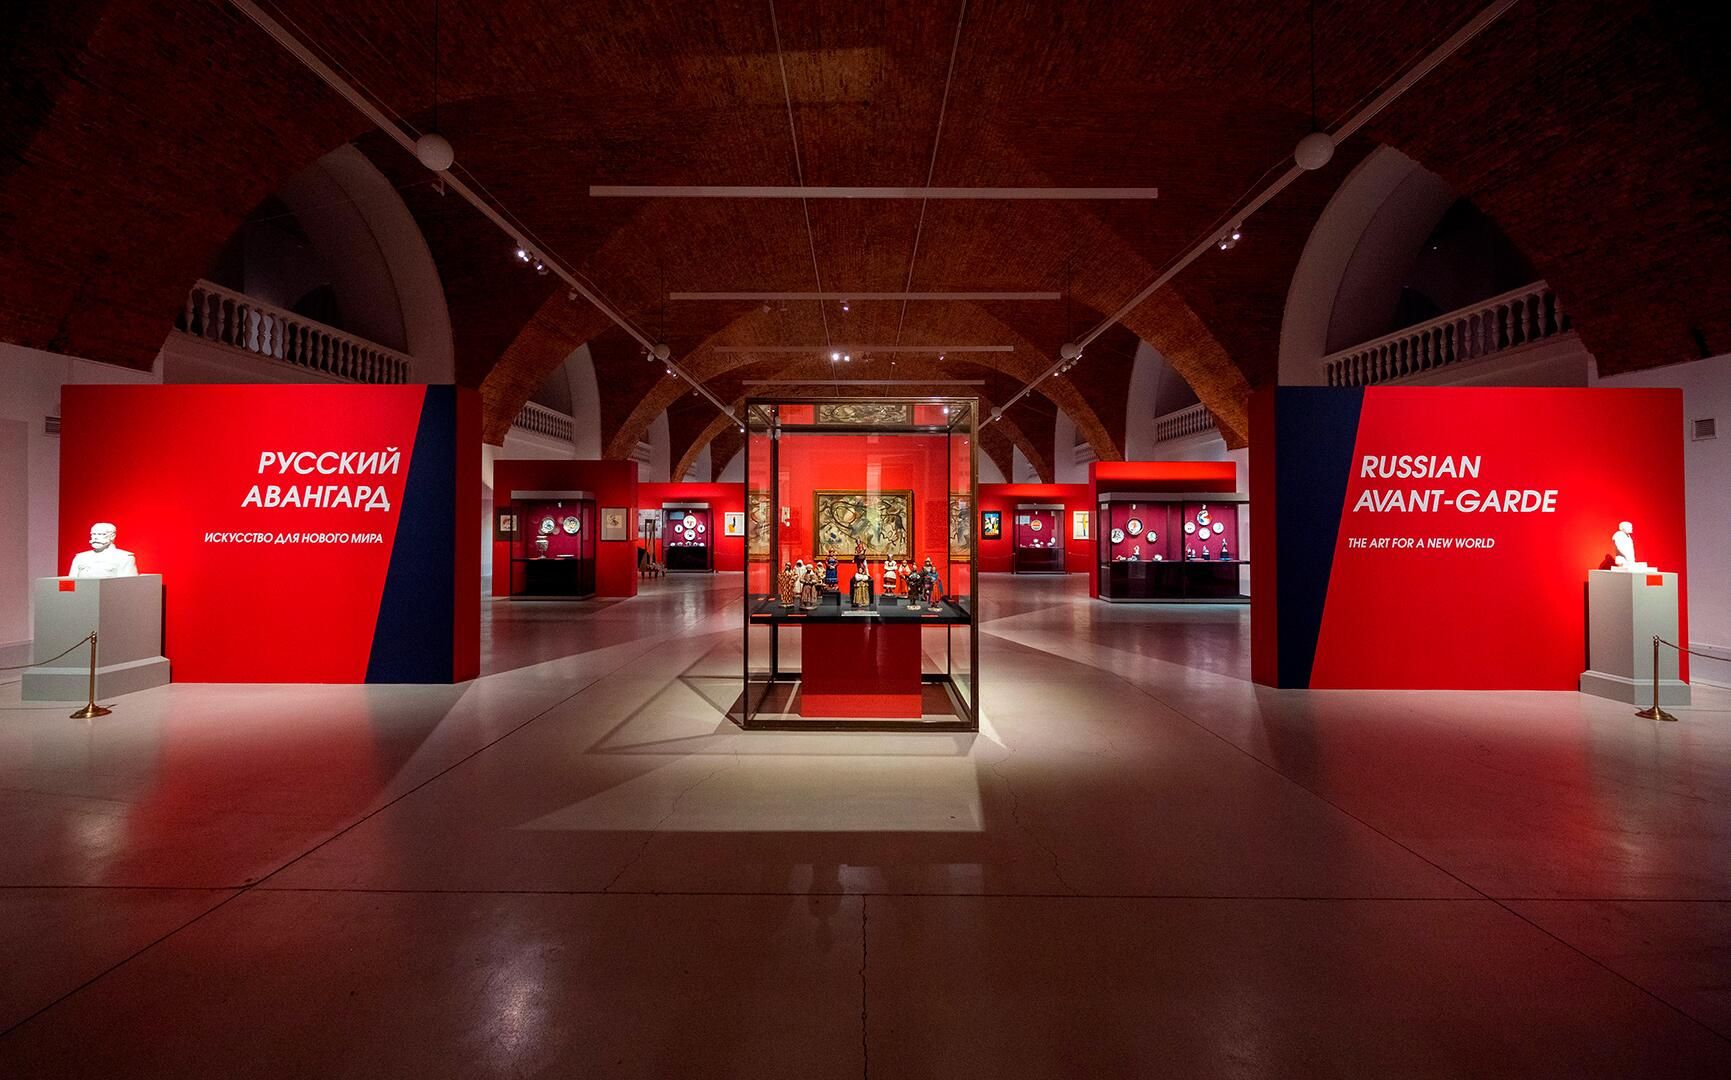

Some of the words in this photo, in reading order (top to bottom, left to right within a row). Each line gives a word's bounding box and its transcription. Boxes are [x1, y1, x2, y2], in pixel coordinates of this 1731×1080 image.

[258, 446, 401, 475] РУССКИЙ
[1360, 454, 1482, 479] RUSSIAN
[240, 484, 391, 512] АВАНГАРД
[1352, 489, 1559, 513] AVANT-GARDE
[204, 532, 273, 544] ИСКУССТВО
[274, 532, 299, 545] ДЛЯ
[301, 532, 349, 544] НОВОГО
[350, 532, 383, 544] МИРА
[1348, 537, 1367, 548] THE
[1369, 537, 1390, 548] ART
[1391, 537, 1414, 548] FOR
[1415, 537, 1425, 548] A
[1426, 537, 1454, 548] NEW
[1455, 537, 1495, 548] WORLD
